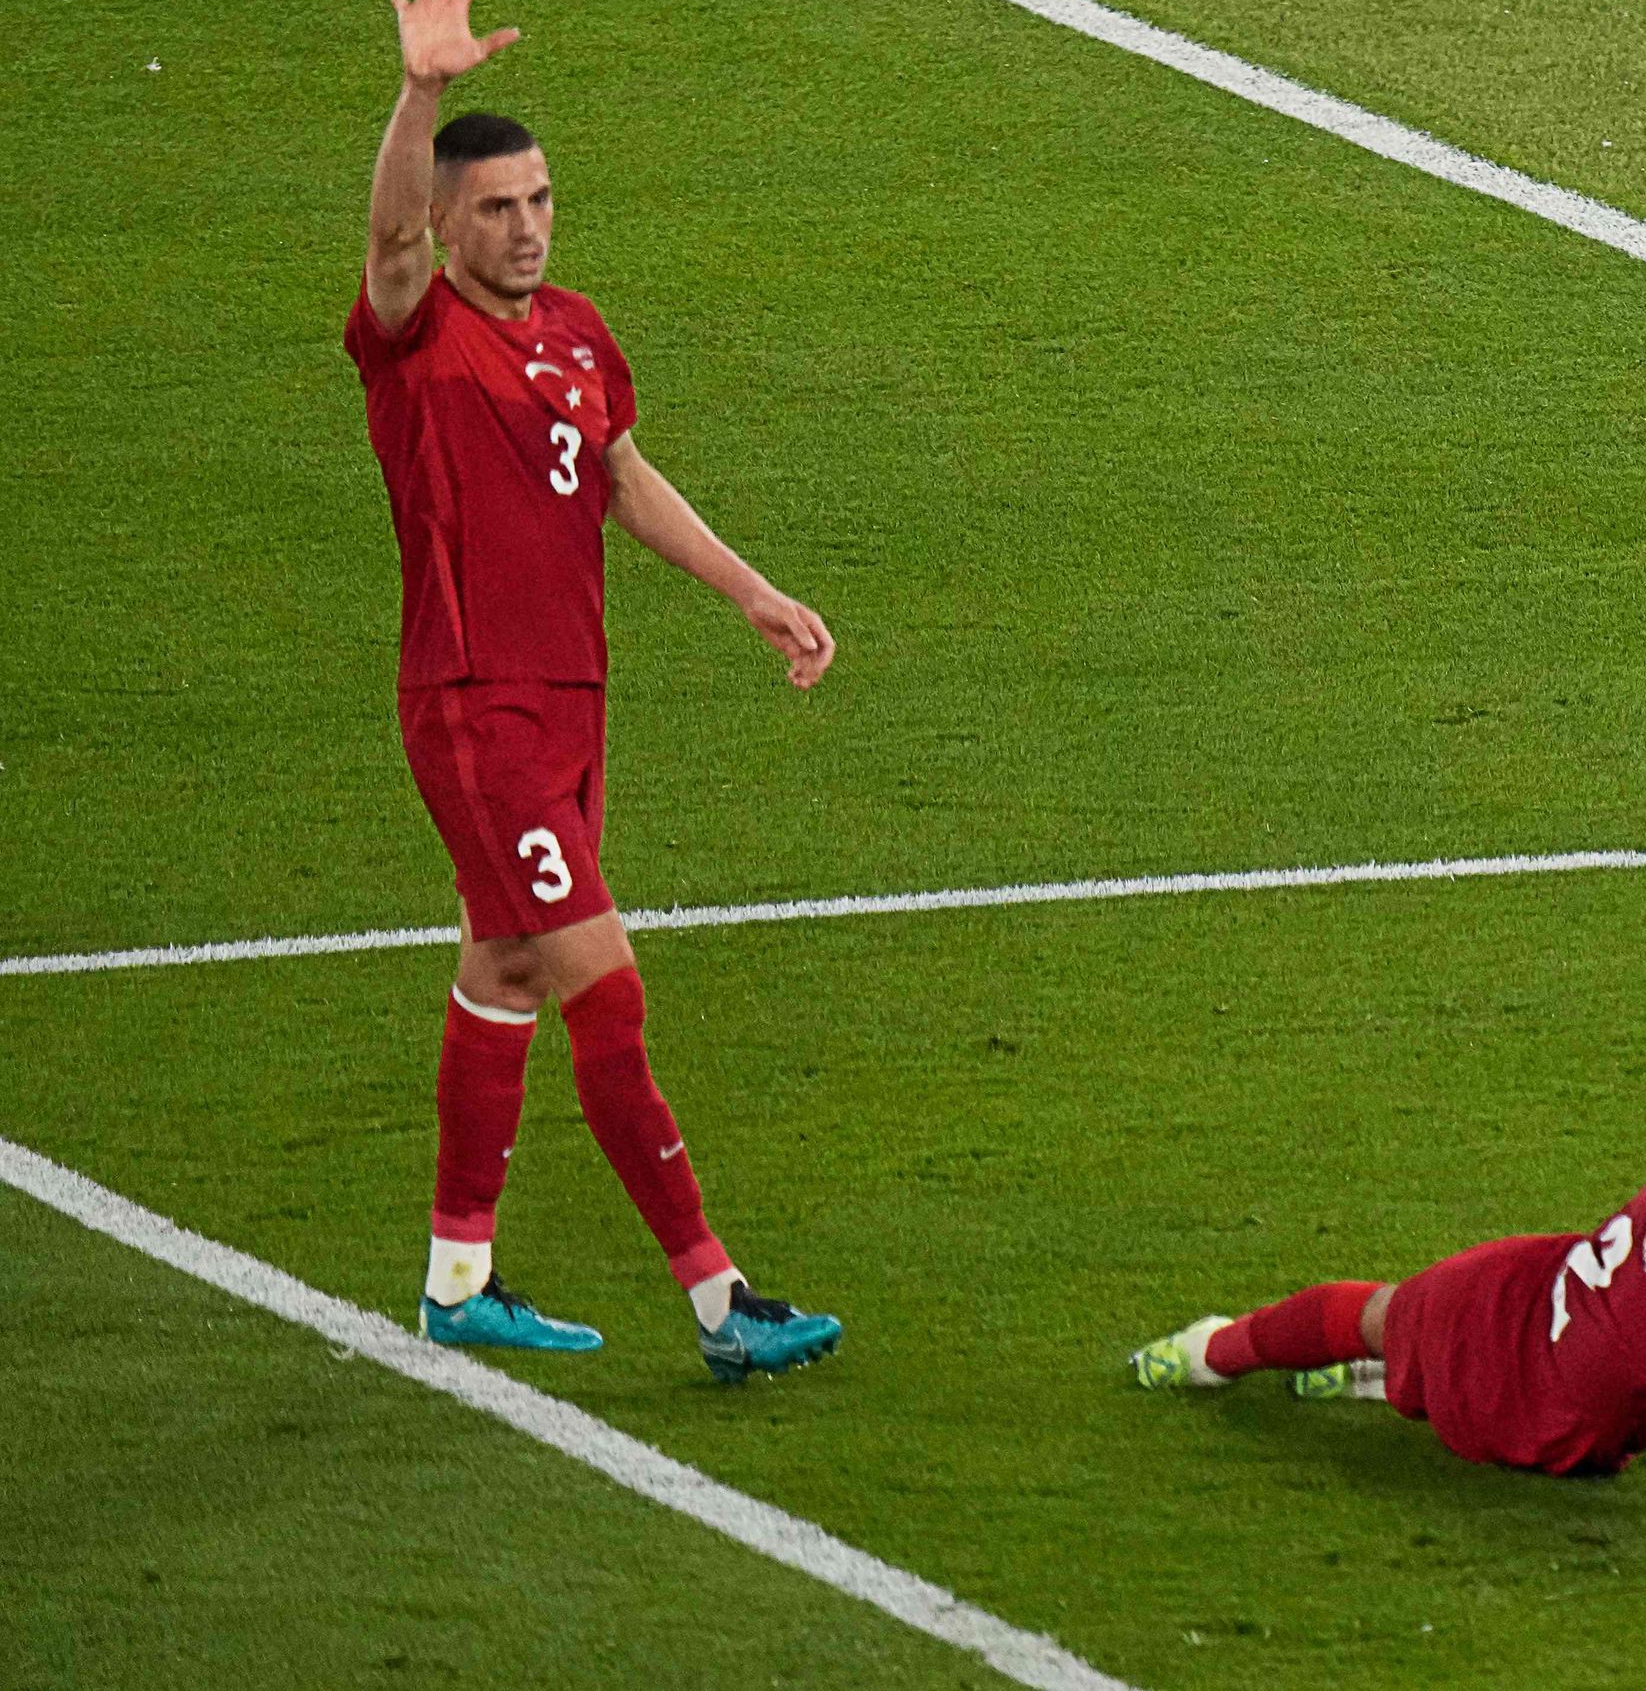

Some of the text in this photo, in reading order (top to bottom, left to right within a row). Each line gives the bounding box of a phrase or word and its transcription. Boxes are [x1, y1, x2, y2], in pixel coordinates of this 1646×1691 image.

[550, 421, 582, 497] 3
[517, 826, 573, 904] 3
[1550, 1214, 1633, 1342] 2
